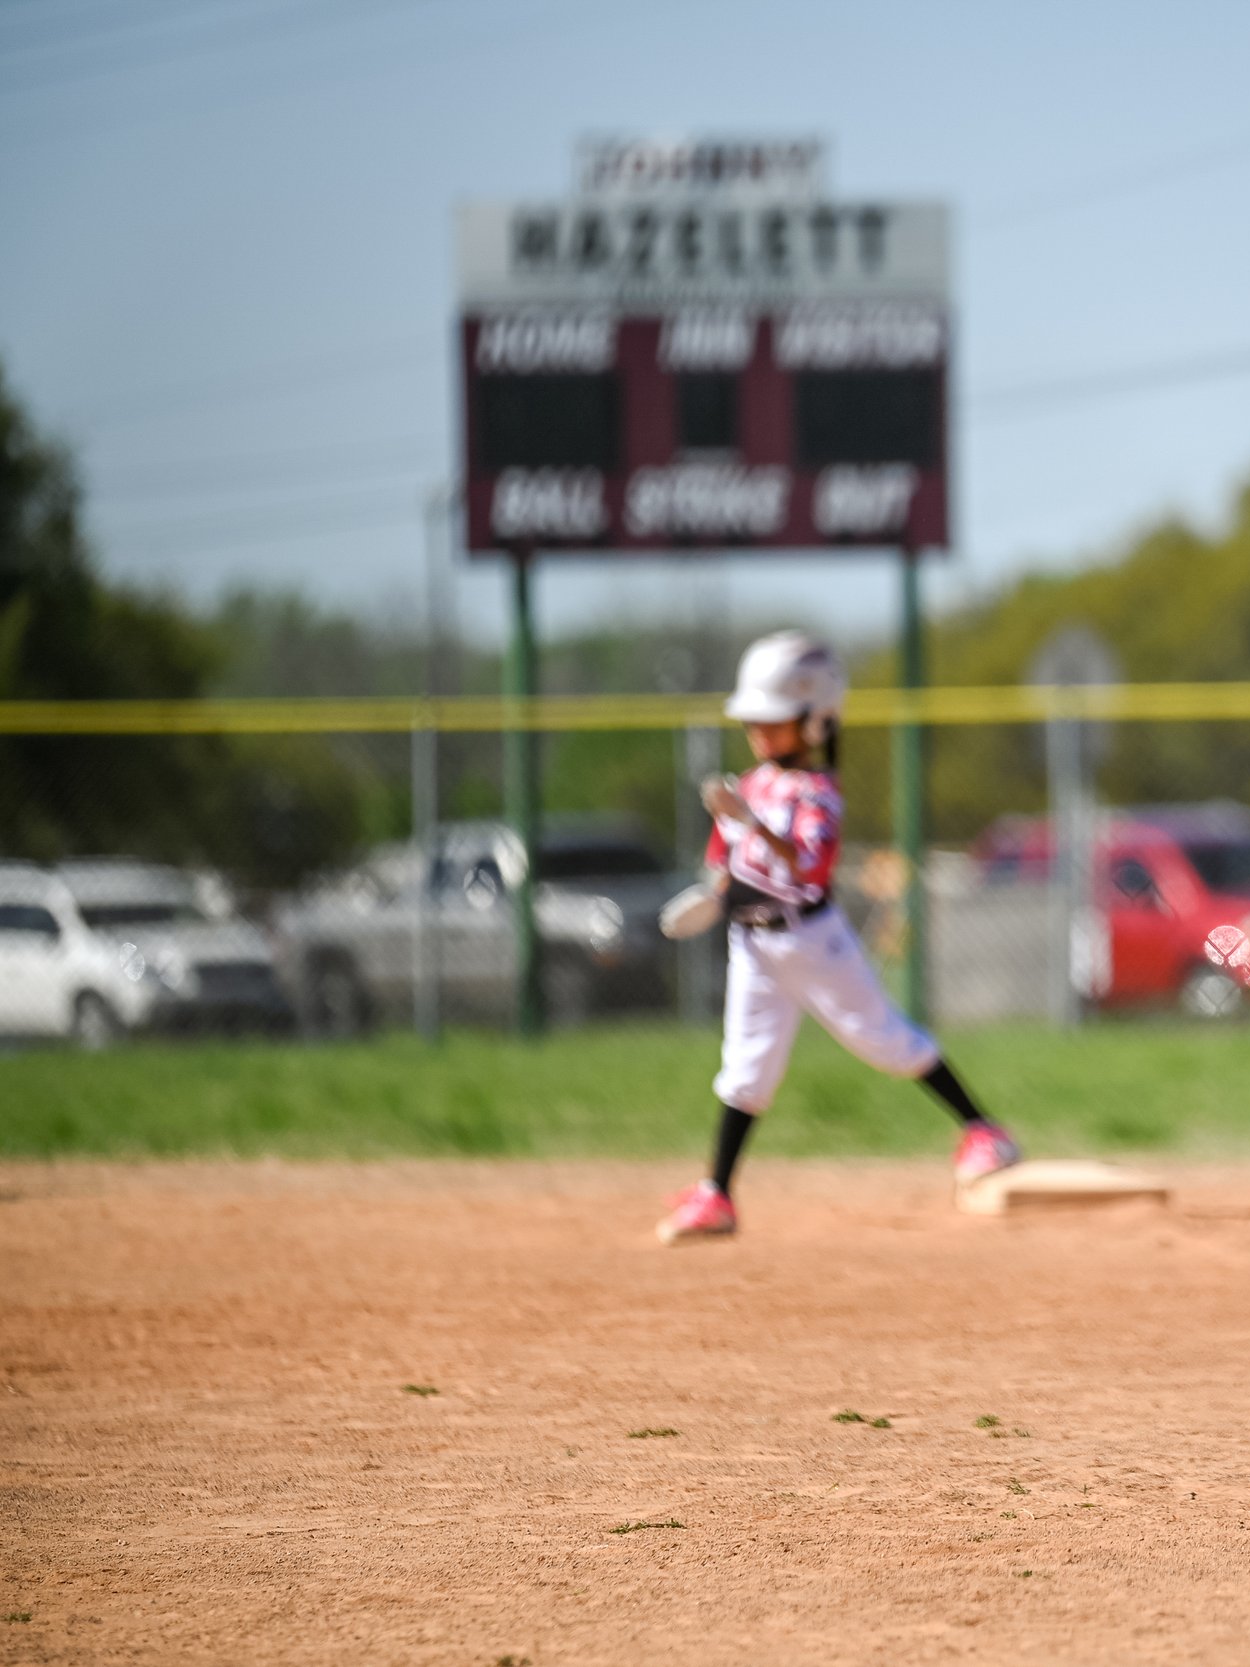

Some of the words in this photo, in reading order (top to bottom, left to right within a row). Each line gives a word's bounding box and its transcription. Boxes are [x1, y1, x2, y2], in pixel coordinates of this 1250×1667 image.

[512, 207, 888, 276] HAZELETT
[478, 316, 614, 370] HOME
[775, 312, 941, 369] VISITOR
[492, 471, 604, 536] BALL
[625, 468, 789, 535] STRIKE
[815, 466, 914, 534] OUT
